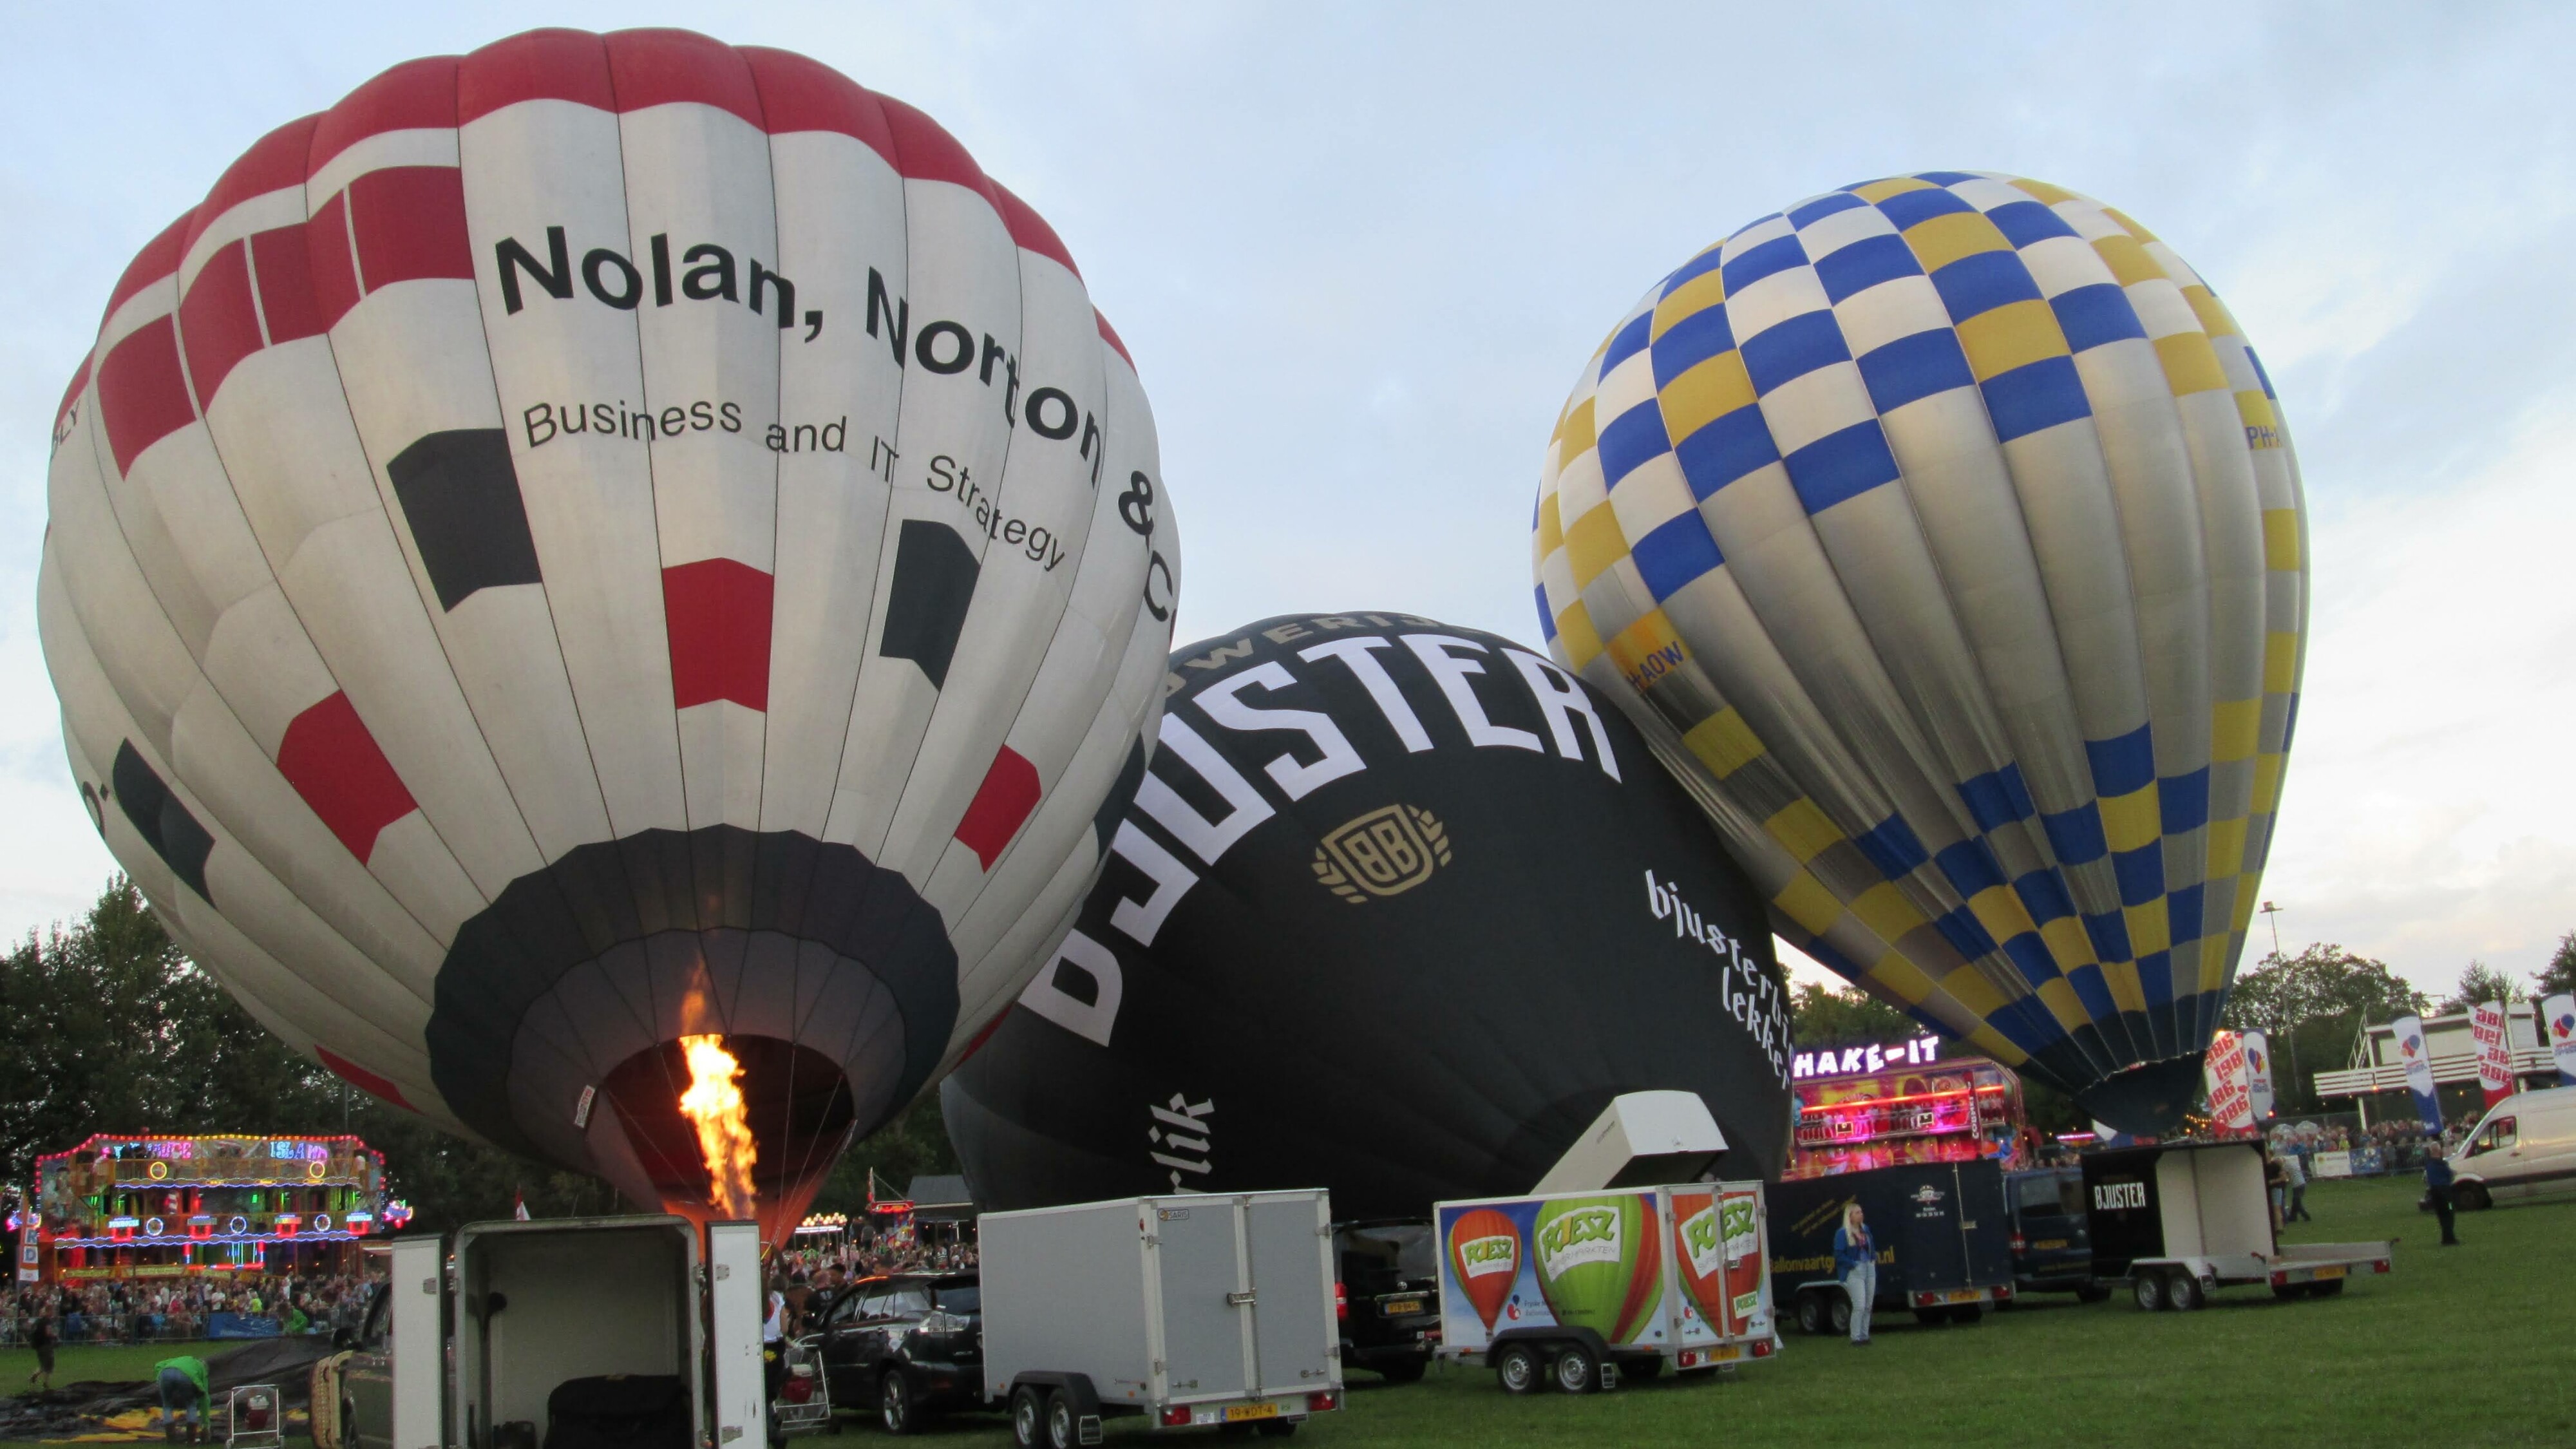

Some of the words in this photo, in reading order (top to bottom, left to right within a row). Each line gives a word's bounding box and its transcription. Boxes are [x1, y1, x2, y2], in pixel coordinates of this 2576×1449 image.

[495, 226, 823, 342] Nolan,
[866, 266, 1101, 489] Norton
[1118, 471, 1154, 555] &
[522, 399, 743, 448] Business
[765, 416, 847, 453] and
[870, 435, 899, 483] IT
[926, 455, 1066, 572] Strategy
[1723, 967, 1790, 1090] lekker
[1169, 1211, 1188, 1219] SARIS
[2094, 1182, 2146, 1209] BJUSTER
[1464, 1238, 1513, 1267] POIESZ
[1542, 1210, 1615, 1263] POIESZ
[1687, 1200, 1755, 1259] POESZ
